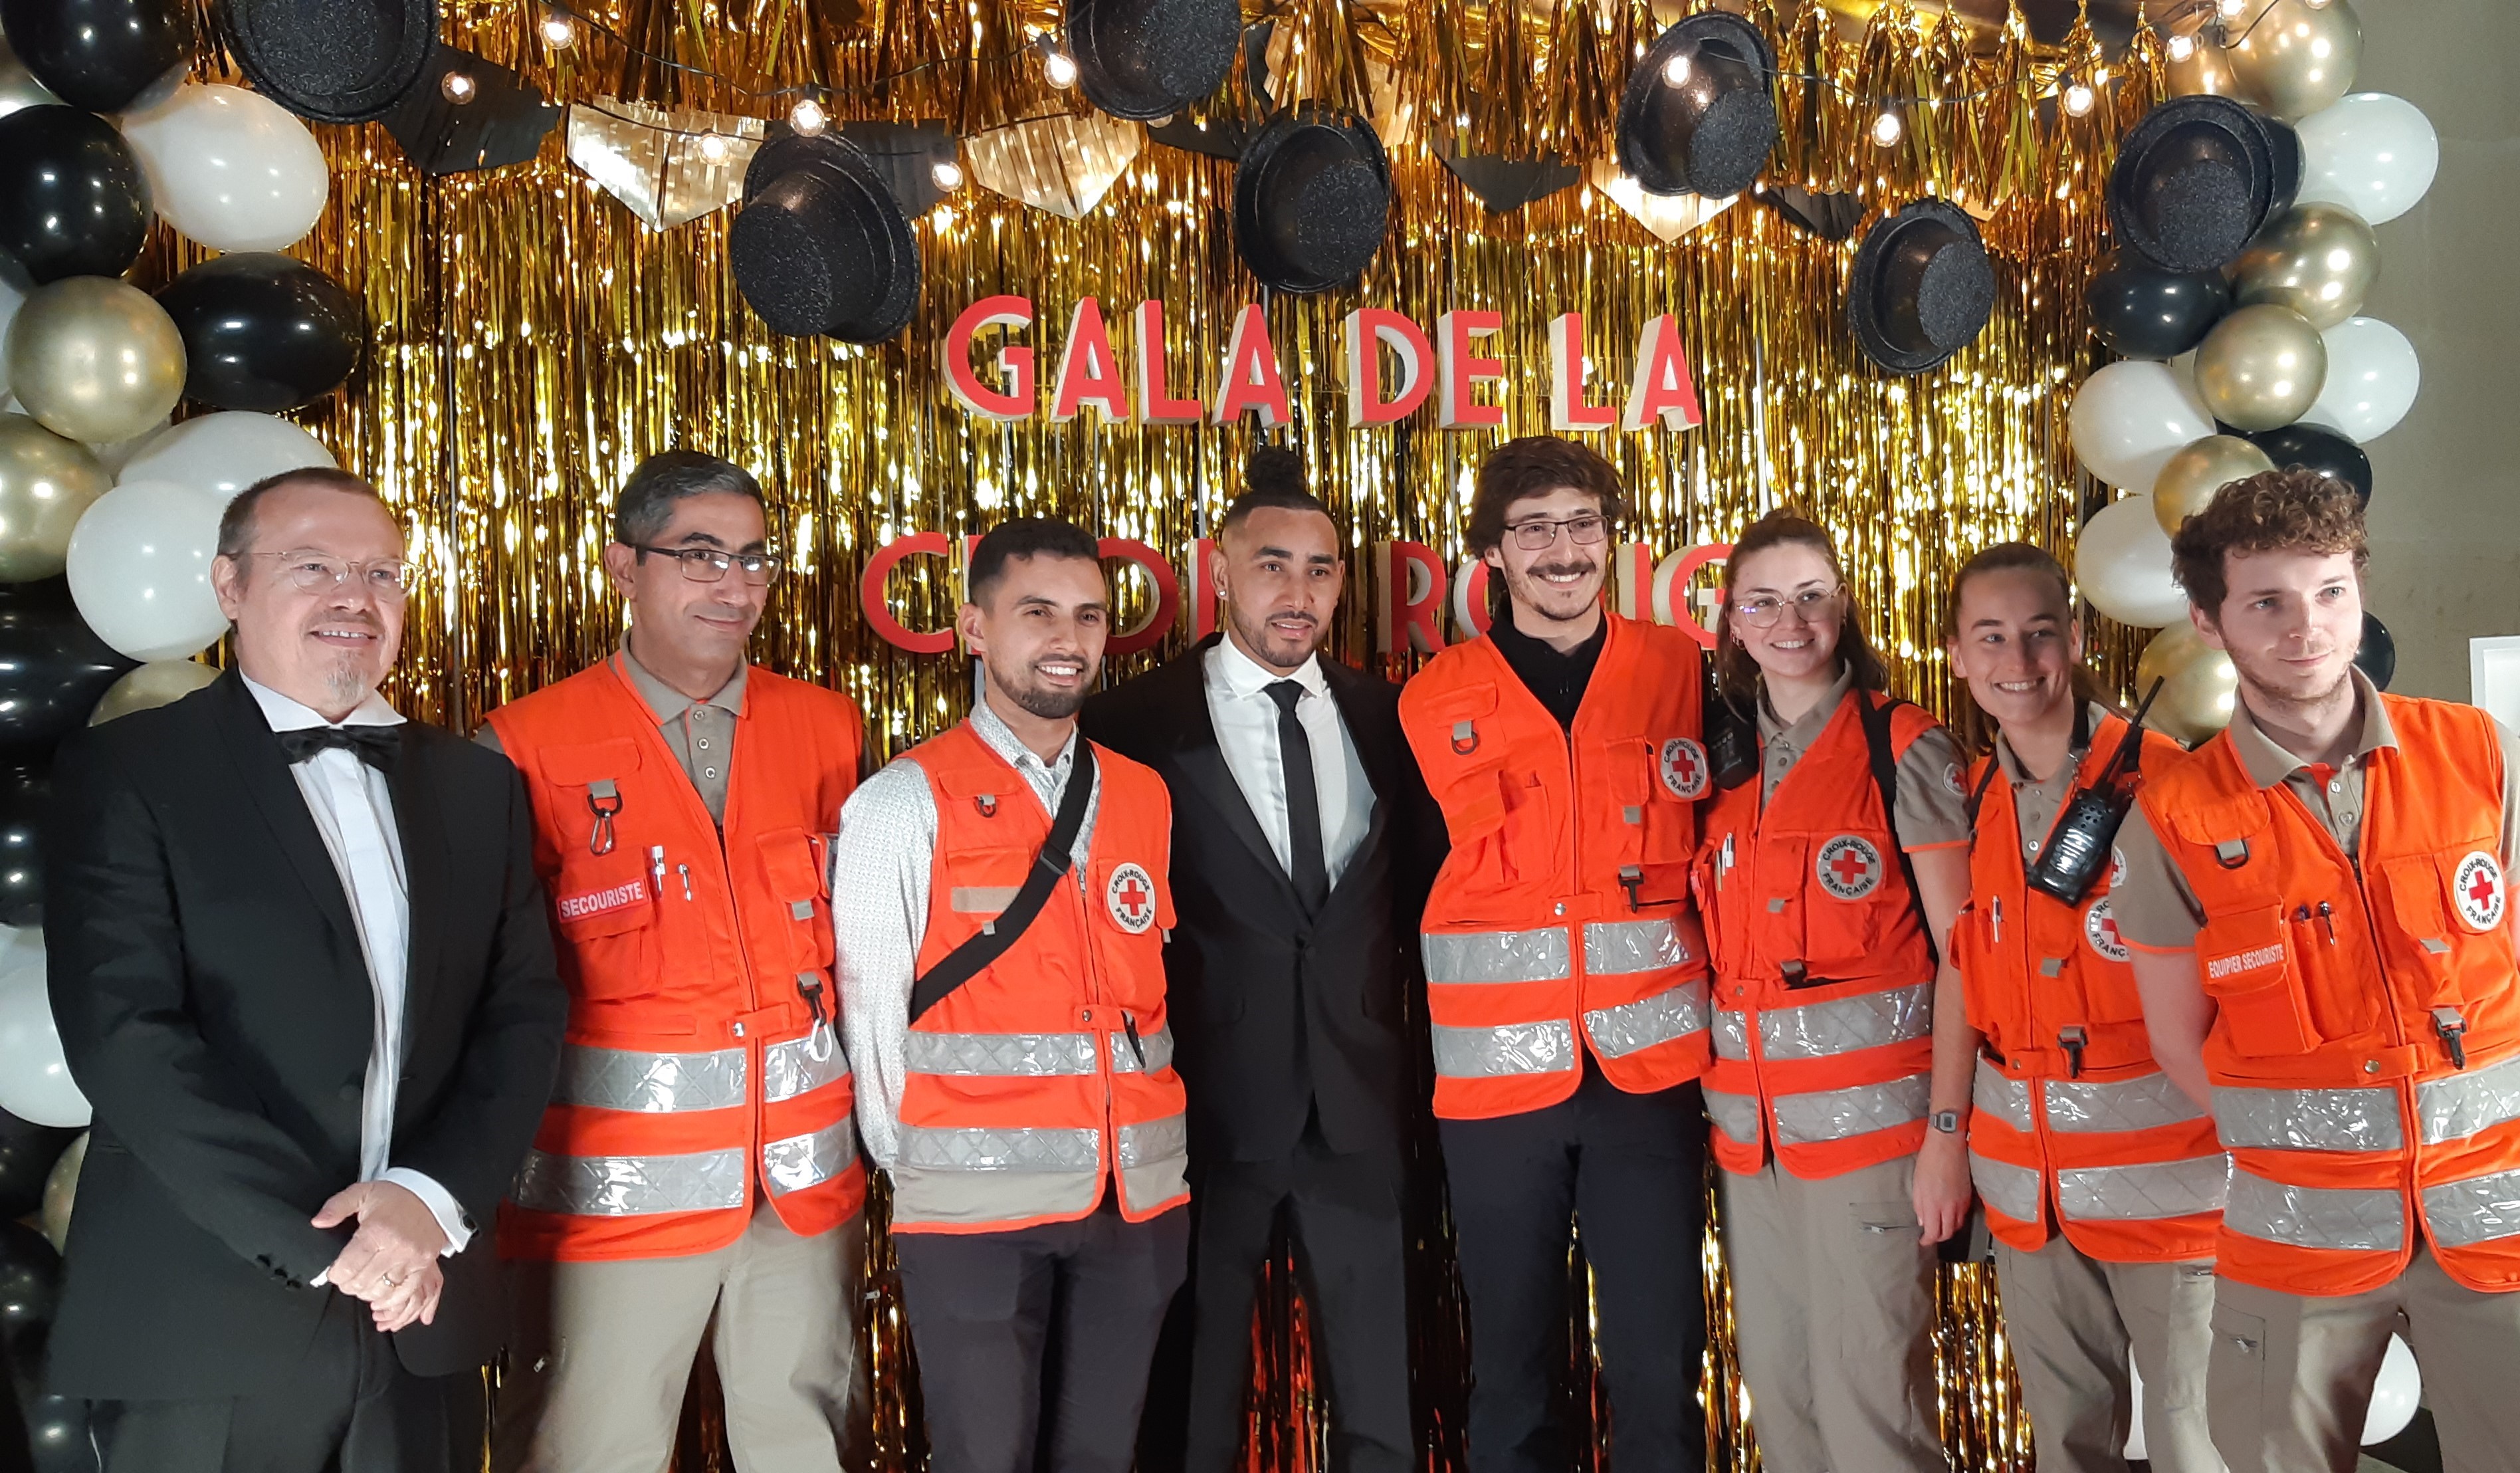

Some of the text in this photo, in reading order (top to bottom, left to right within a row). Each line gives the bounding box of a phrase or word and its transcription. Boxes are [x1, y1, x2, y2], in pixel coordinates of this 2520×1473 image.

[942, 295, 1701, 431] GALA DE LA
[1823, 840, 1875, 864] CROIX-ROUGE
[1112, 869, 1150, 893] CROIX-ROUGE
[561, 881, 643, 917] SECOURISTE
[2208, 943, 2284, 978] EQUIPIER SECOURISTE
